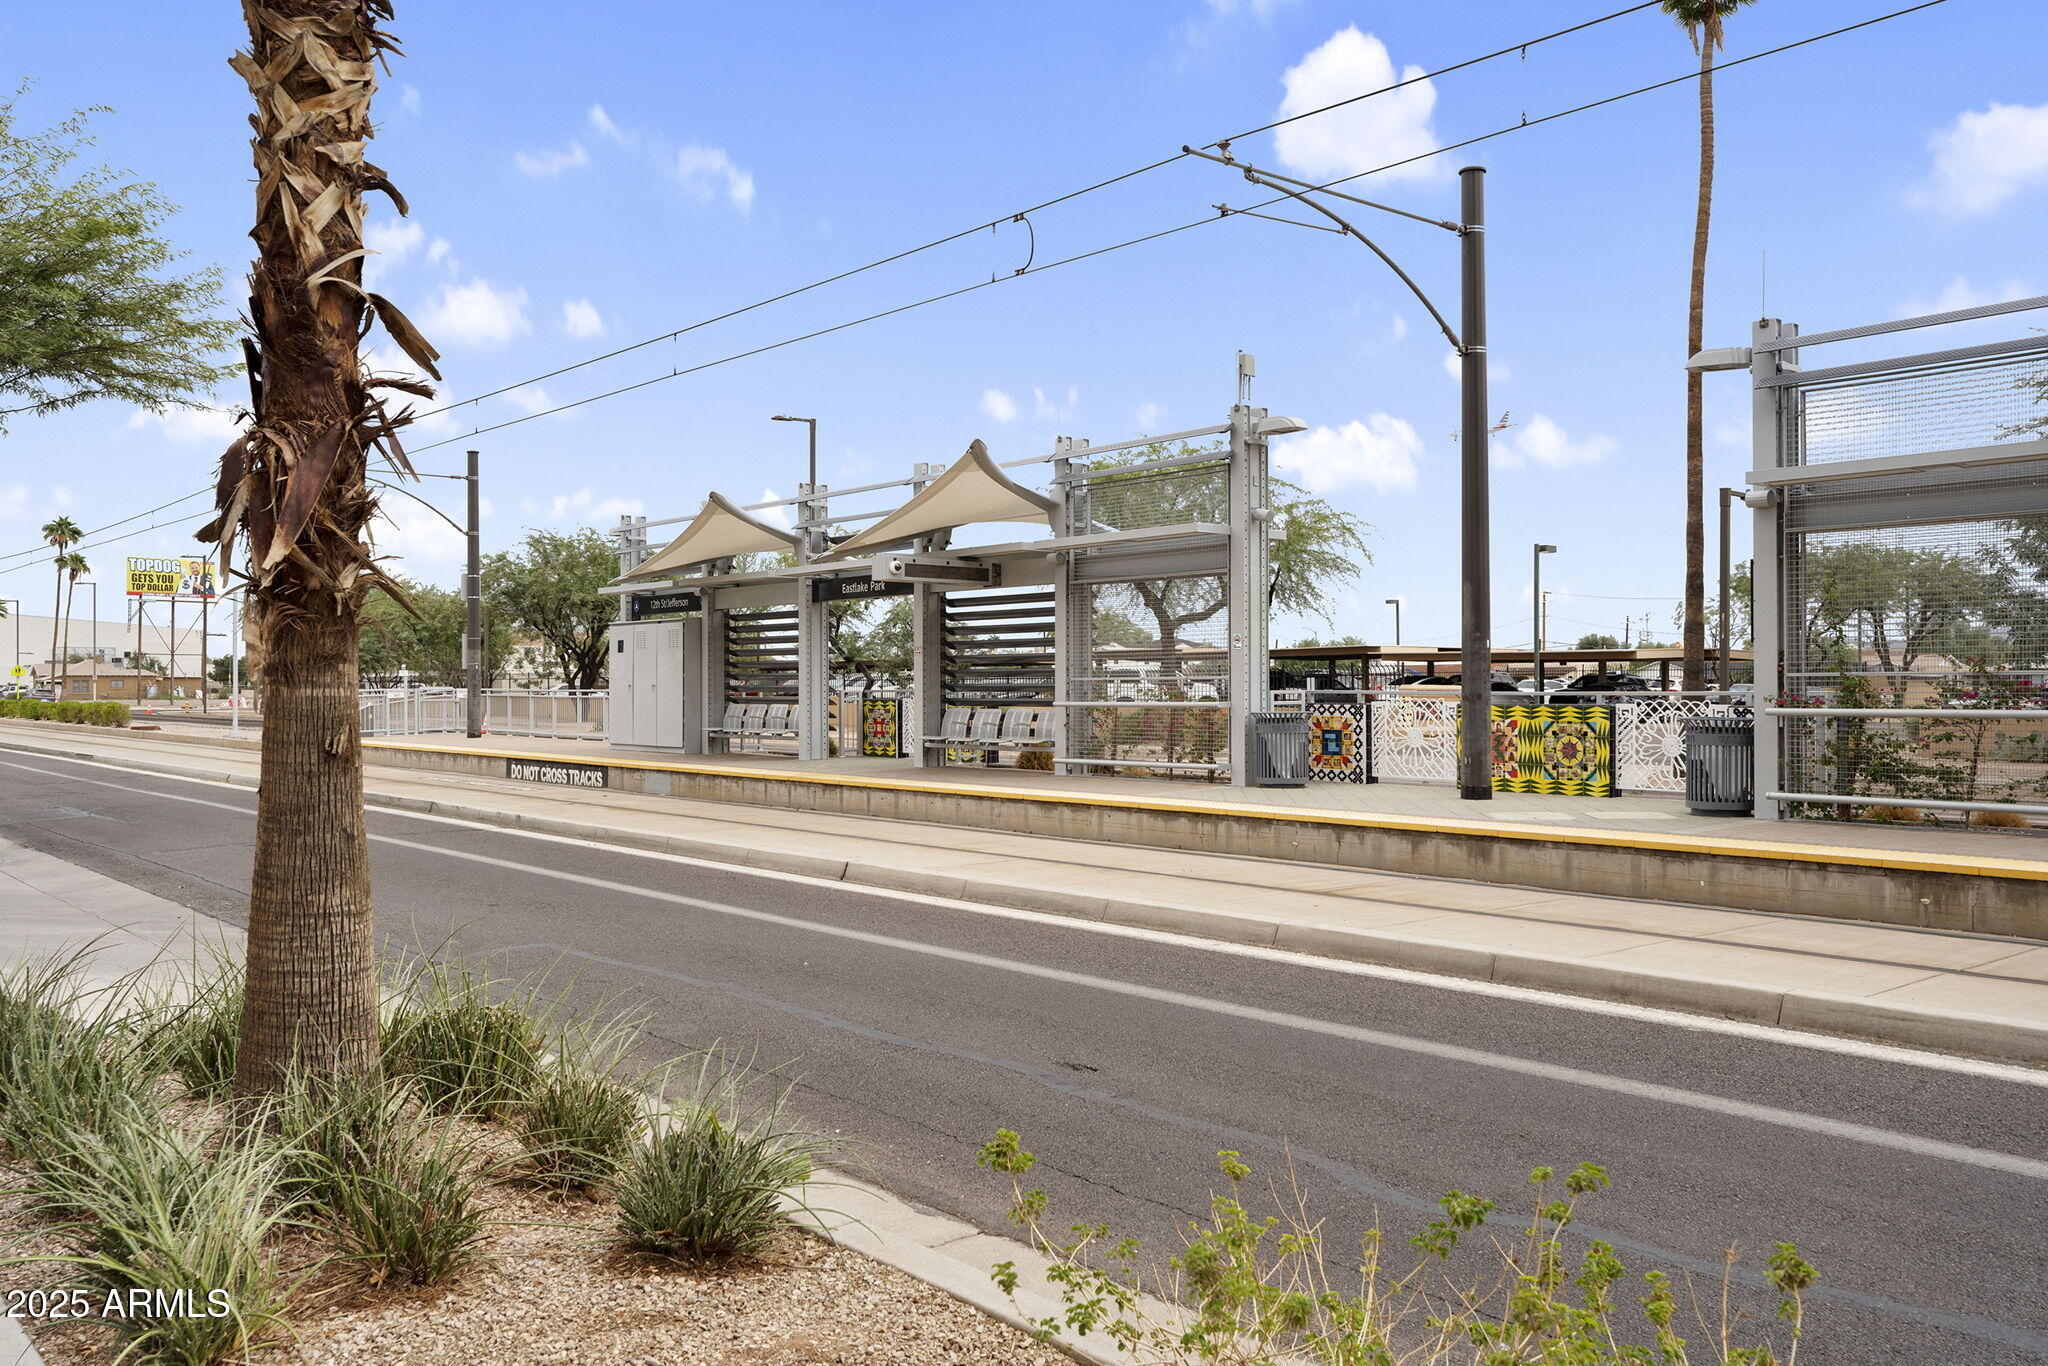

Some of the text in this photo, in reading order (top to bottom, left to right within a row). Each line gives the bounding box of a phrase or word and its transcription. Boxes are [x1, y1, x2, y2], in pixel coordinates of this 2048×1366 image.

[127, 557, 181, 574] TOPDOG
[131, 573, 174, 584] GETS YOU
[147, 583, 174, 592] DOLLAR
[842, 581, 886, 594] Eastlake Park
[650, 600, 660, 609] 12th
[510, 763, 603, 788] DO NOT CROSS TRACKS
